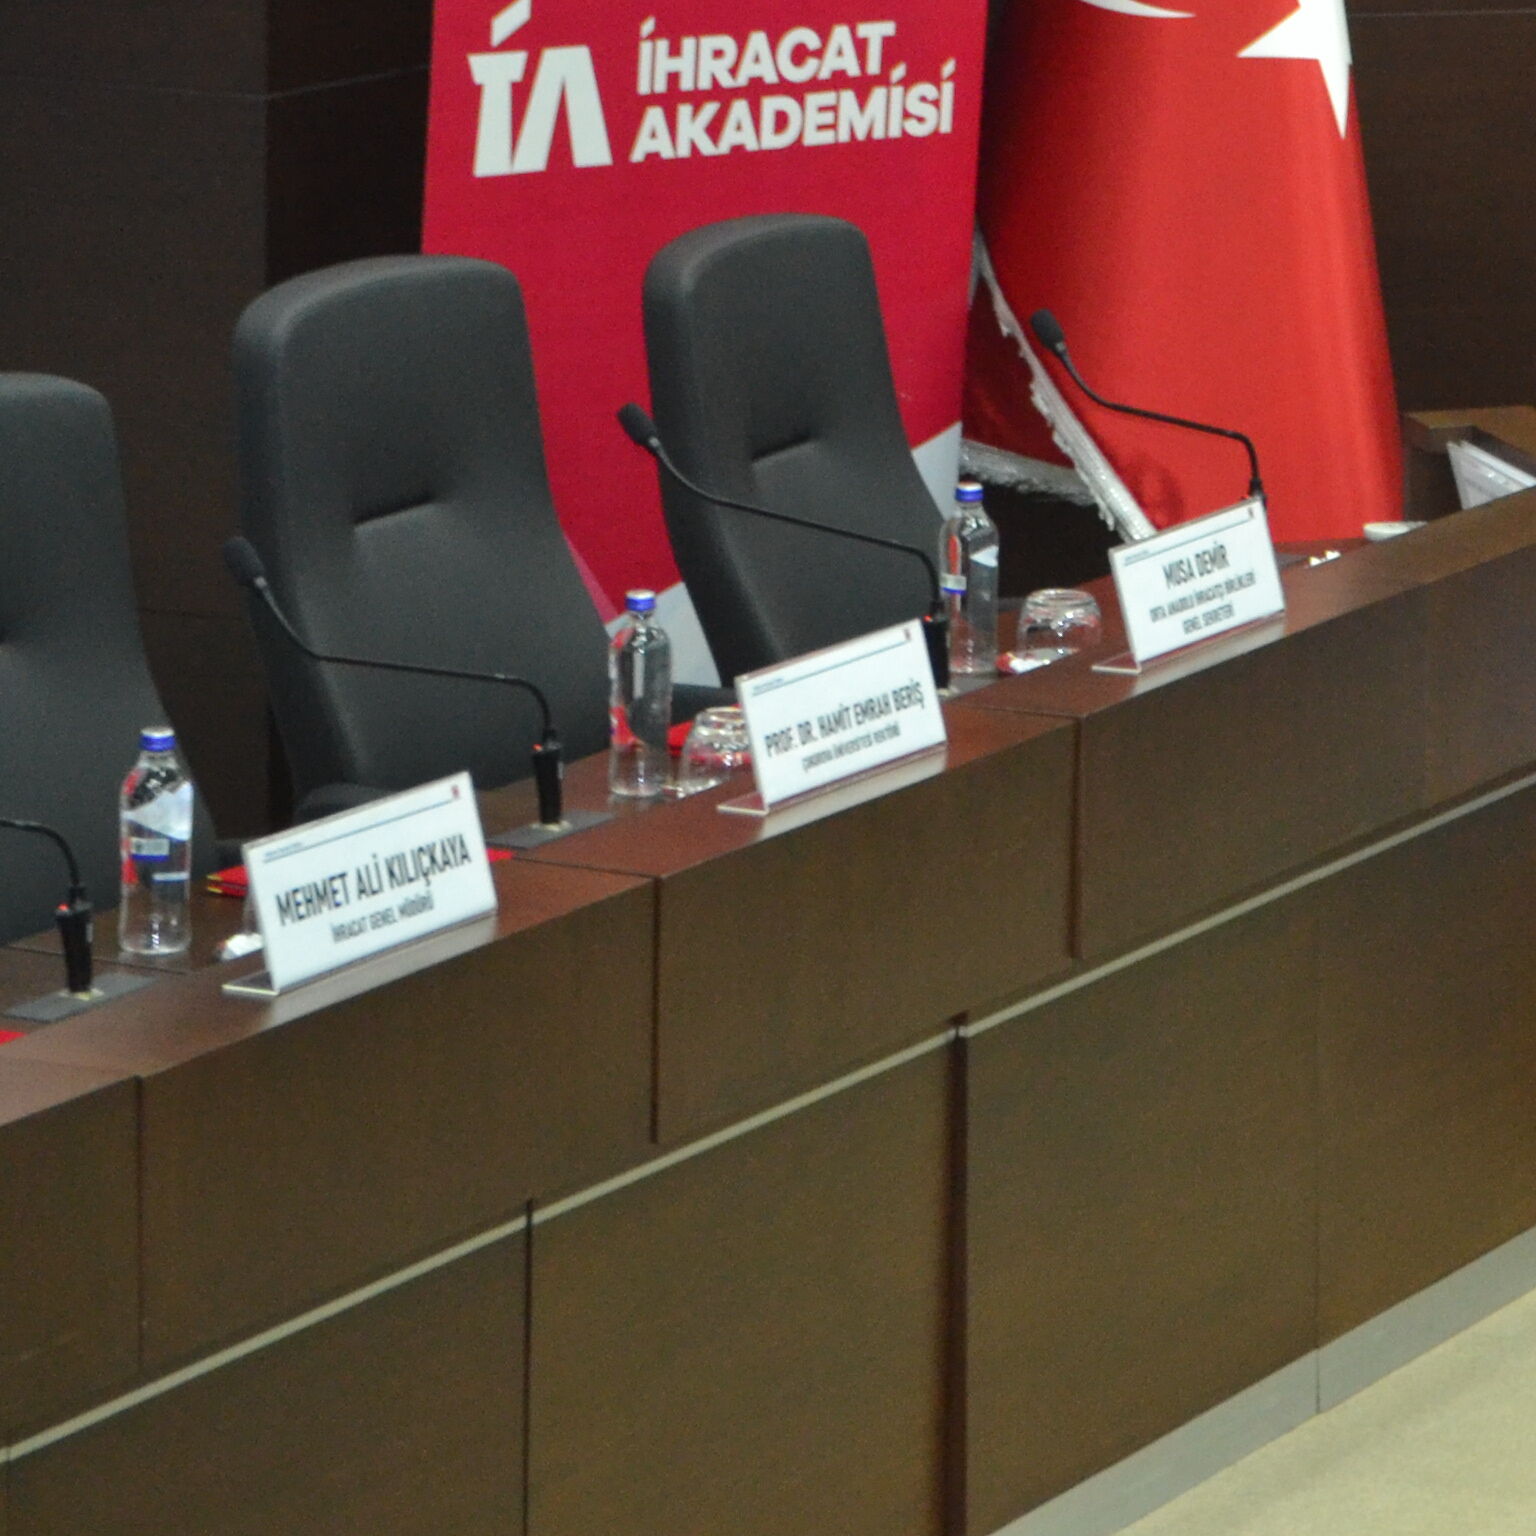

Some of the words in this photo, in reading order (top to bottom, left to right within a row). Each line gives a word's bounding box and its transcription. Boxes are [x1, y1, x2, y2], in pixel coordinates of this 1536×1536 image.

[637, 15, 897, 95] İHRACAT
[629, 57, 957, 163] AKADEMİSİ
[816, 703, 854, 739] HAMİT
[852, 692, 893, 726] EMRAH
[275, 871, 352, 928] MEHMET
[355, 853, 385, 901] ALİ
[384, 832, 473, 888] KILIÇKAYA
